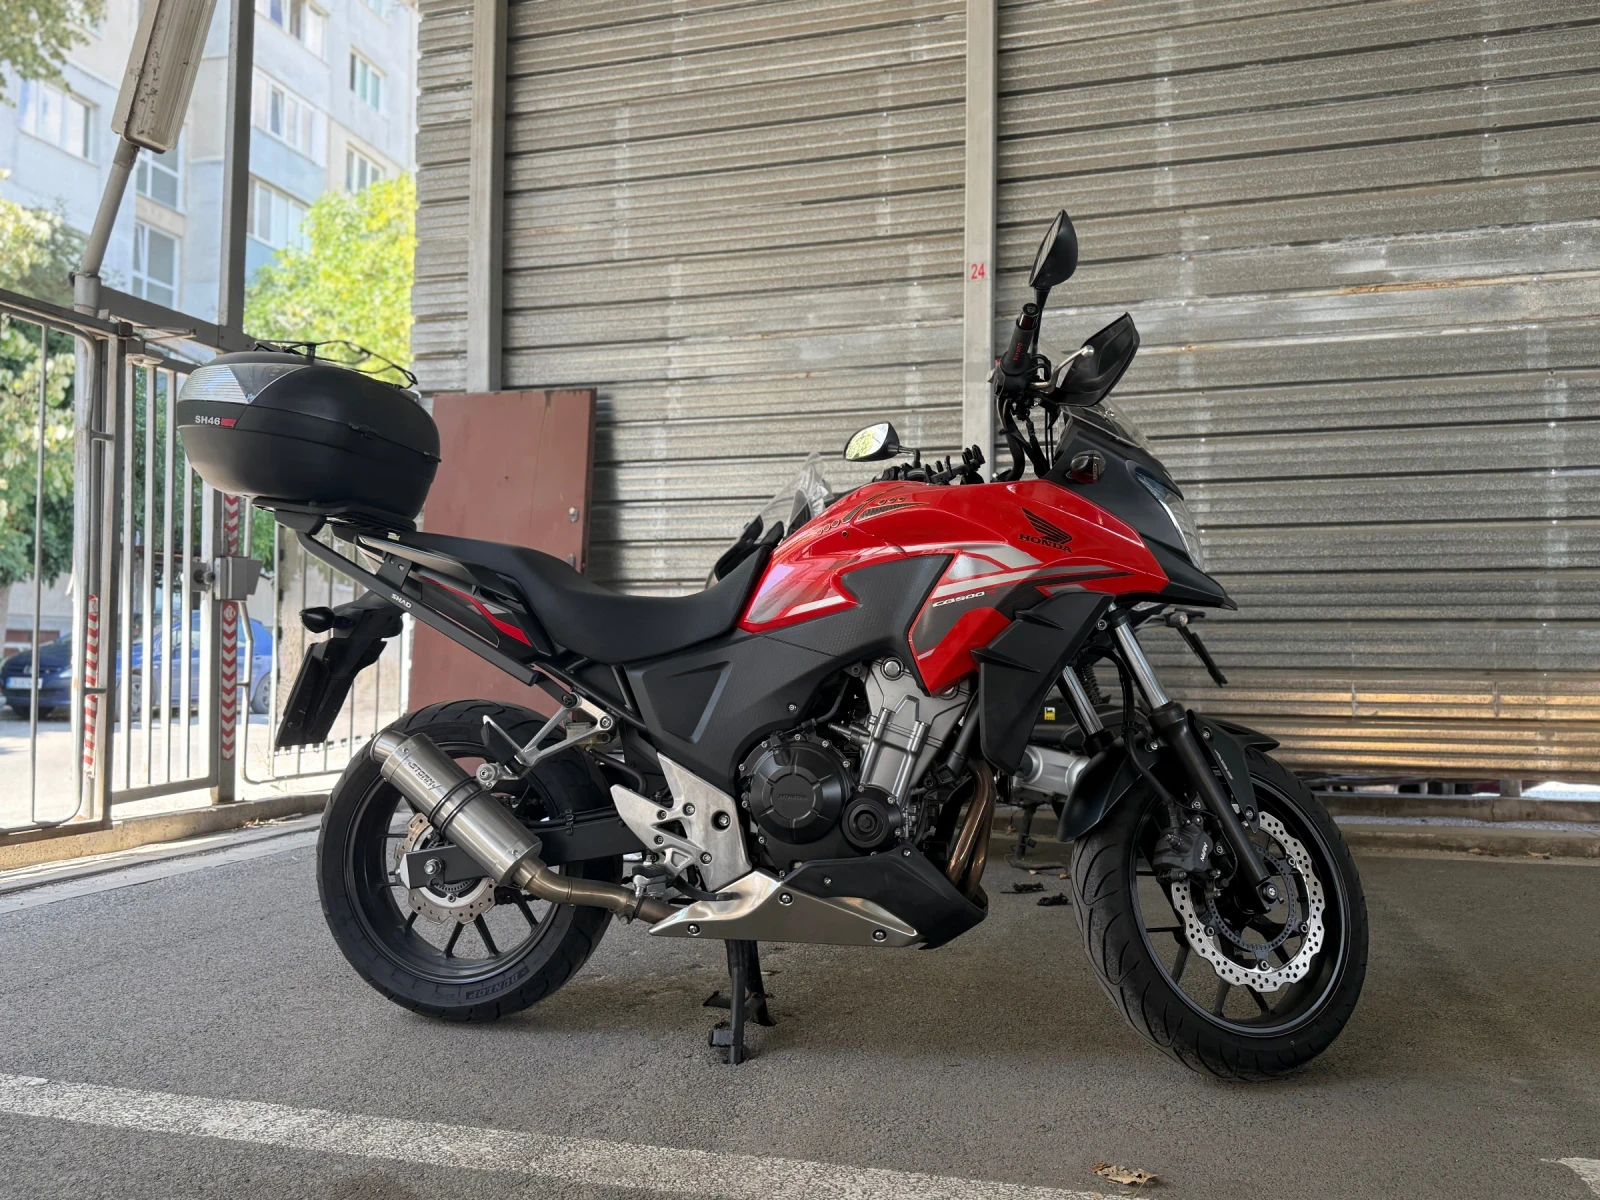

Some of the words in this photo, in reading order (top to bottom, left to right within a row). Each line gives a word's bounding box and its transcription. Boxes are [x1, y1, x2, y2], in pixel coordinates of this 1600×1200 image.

[971, 262, 985, 280] 24
[194, 414, 221, 426] SH46
[1019, 533, 1073, 554] HONDA
[391, 592, 412, 609] SHAD
[407, 761, 437, 788] STORM
[468, 974, 519, 999] DUNLOP
